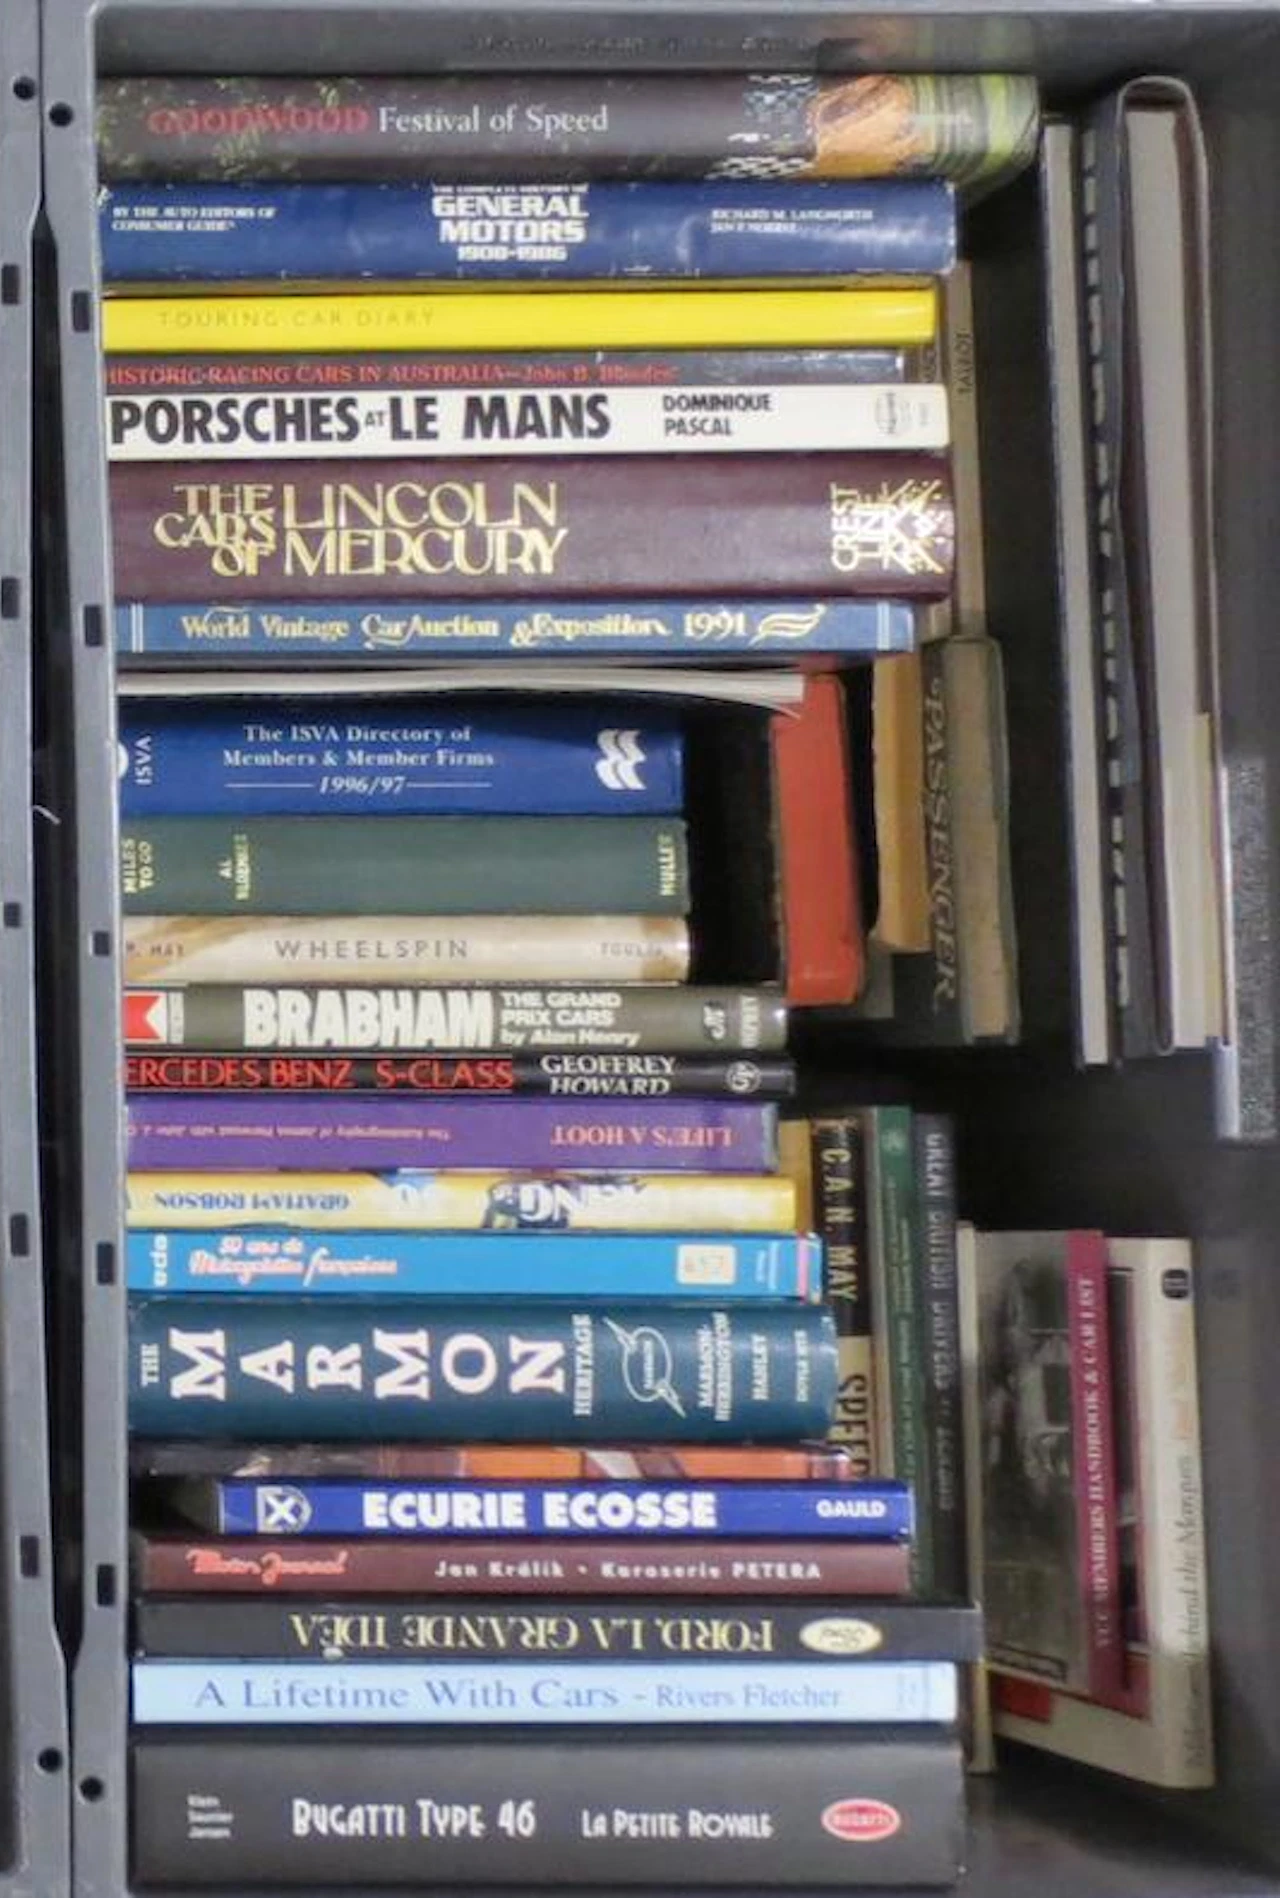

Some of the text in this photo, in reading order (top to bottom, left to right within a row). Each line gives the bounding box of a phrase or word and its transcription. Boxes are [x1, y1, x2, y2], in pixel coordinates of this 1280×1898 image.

[433, 194, 590, 218] GENERAL
[440, 220, 587, 243] MOTORS
[160, 309, 436, 328] TOURING CAR DIARY
[662, 394, 772, 411] DOMINIQUE
[110, 394, 611, 444] PORSCHES AT LE MANS
[664, 419, 733, 436] PASCAL
[283, 481, 558, 528] LINCOLN
[285, 528, 568, 577] MERCURY
[181, 608, 747, 649] World Vintage Car Auction 1991
[244, 725, 471, 745] The ISVA Directory of
[223, 749, 494, 768] Members & Member Firms
[319, 775, 405, 796] 1996/97
[275, 940, 468, 959] WHEELSPIN
[500, 992, 622, 1008] THE GRAND
[243, 991, 493, 1047] BRABHAM
[501, 1009, 615, 1027] PRIX CARS
[541, 1056, 676, 1076] GEOFFREY
[549, 1076, 671, 1096] HOWARD
[1079, 1321, 1098, 1364] CAR
[1082, 1389, 1107, 1502] HANDBOOK
[363, 1492, 886, 1529] ECURIE ECOSSE GAULD
[195, 1678, 840, 1710] A Lifetime With Cars Rivers Fletcher
